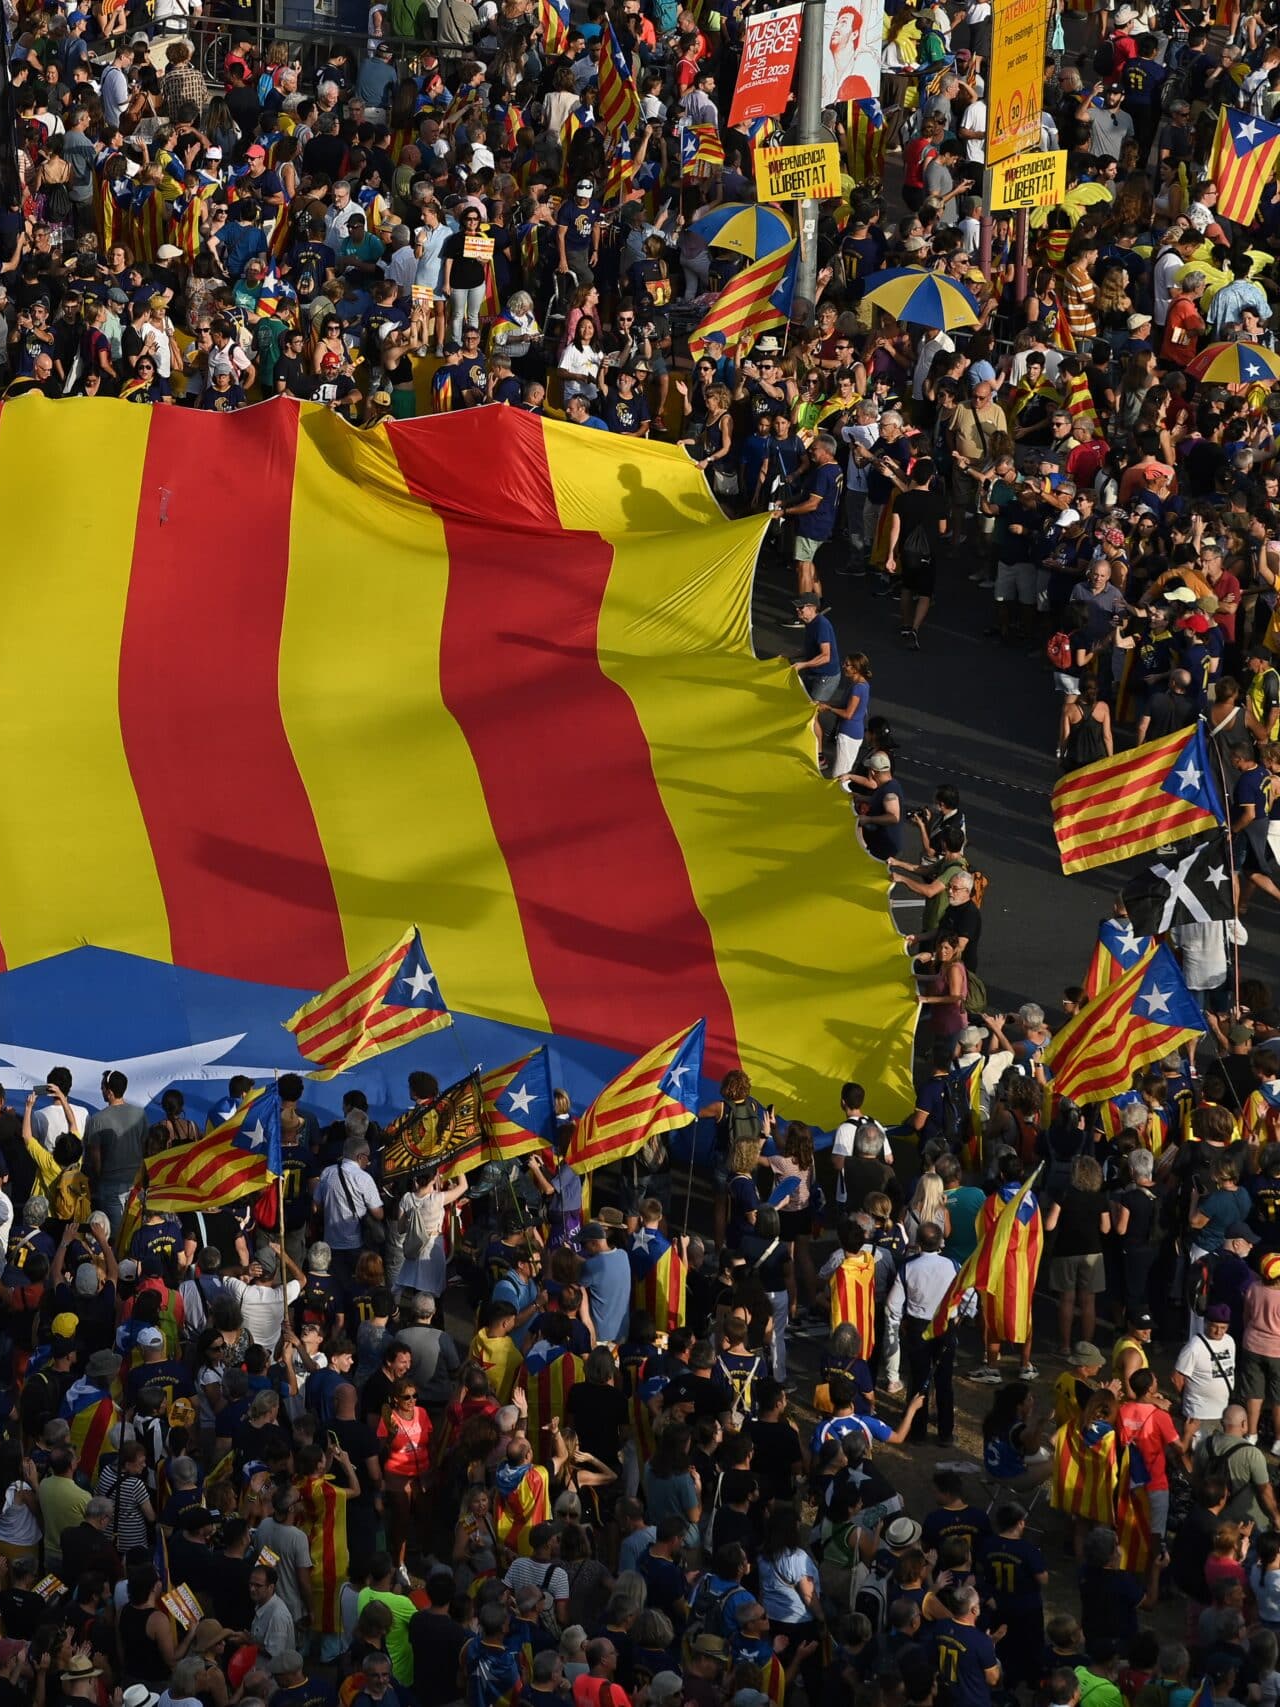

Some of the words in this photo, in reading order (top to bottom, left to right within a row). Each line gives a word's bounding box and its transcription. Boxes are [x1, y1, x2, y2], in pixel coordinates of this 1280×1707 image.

[751, 66, 766, 81] SET
[768, 64, 791, 77] 2023
[1011, 104, 1020, 119] 30
[770, 164, 826, 196] LLIBERTAT
[1003, 172, 1056, 204] LLIBERTAT
[991, 1561, 1016, 1594] 11
